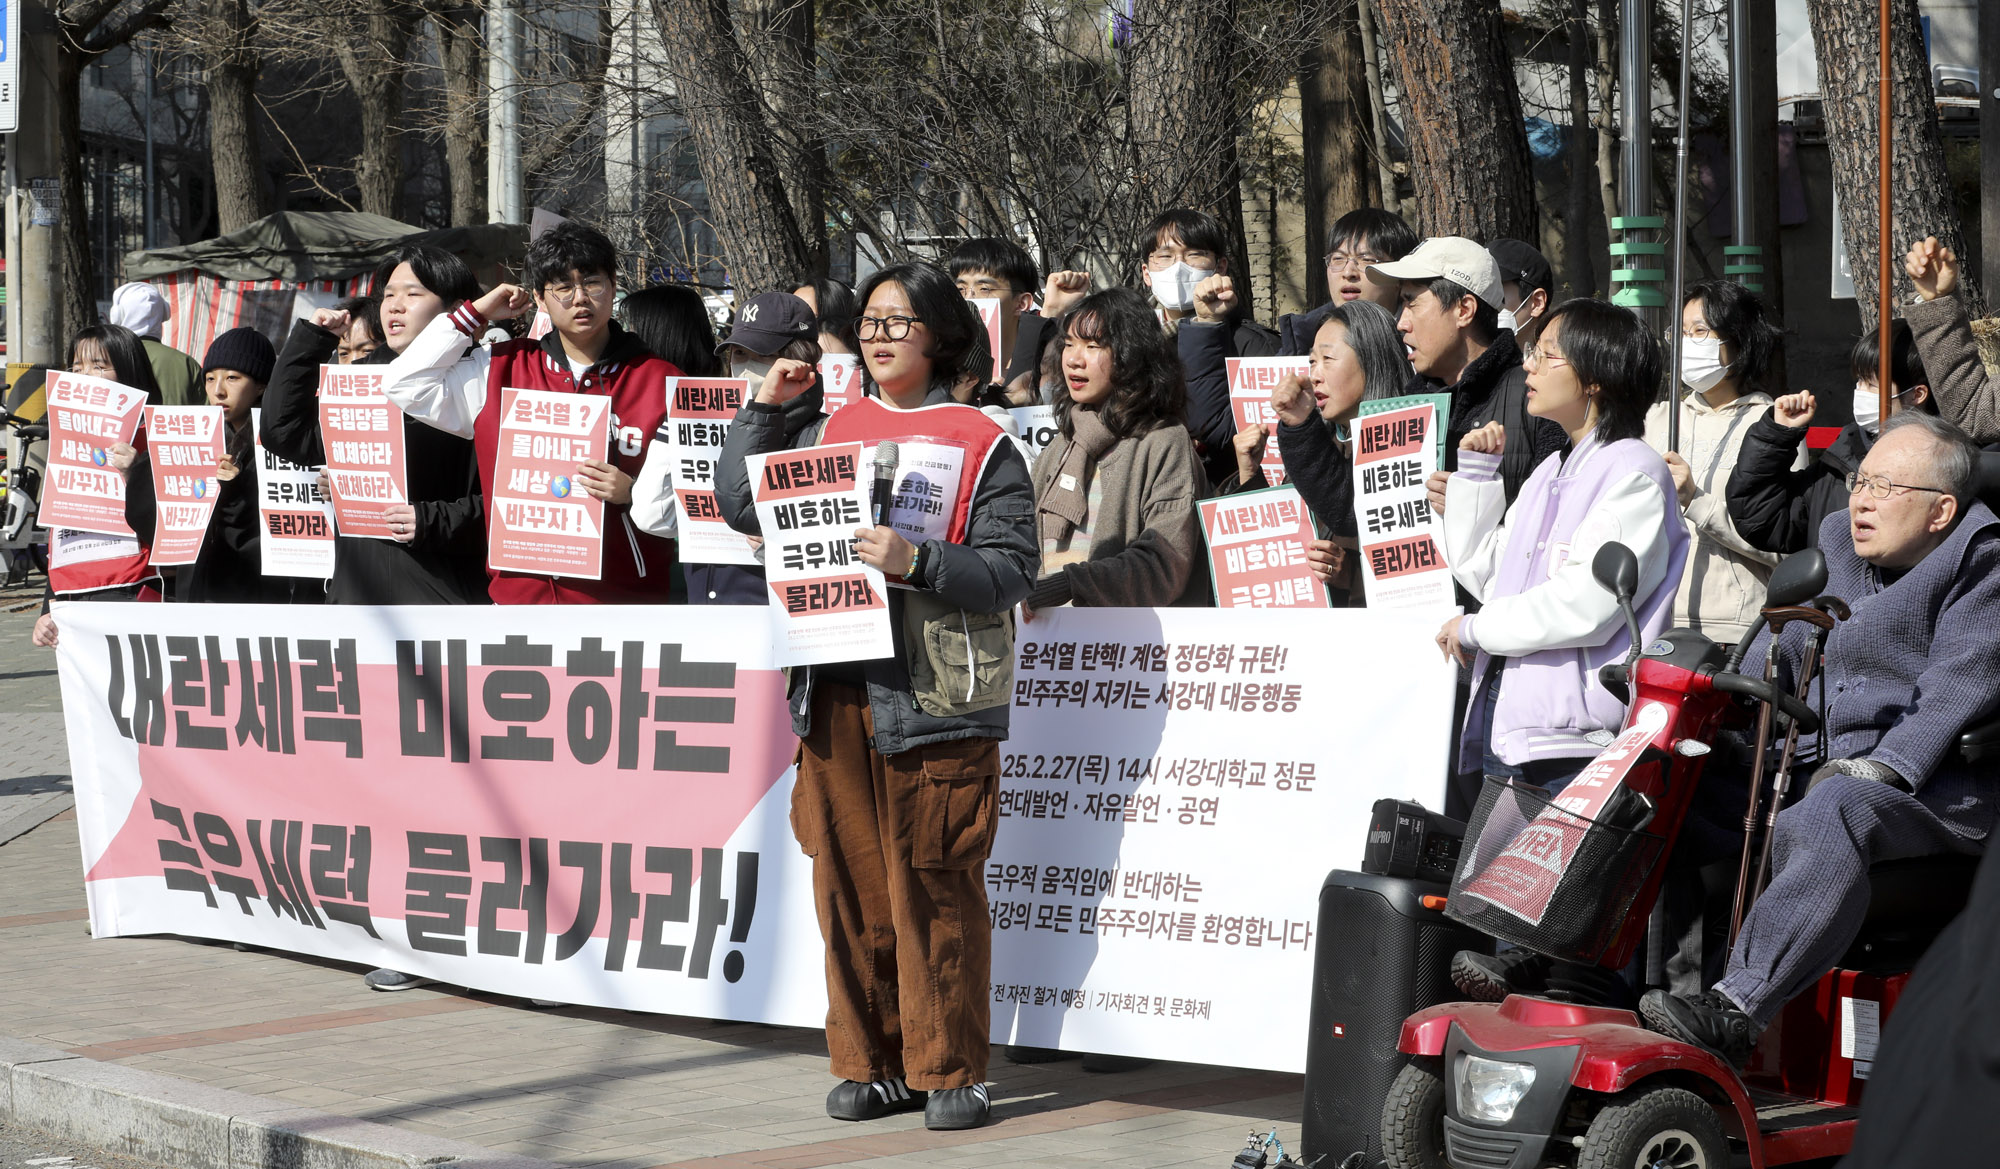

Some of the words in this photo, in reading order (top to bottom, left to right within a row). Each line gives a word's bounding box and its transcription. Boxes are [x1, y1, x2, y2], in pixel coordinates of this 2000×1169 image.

[1451, 269, 1471, 282] IZOD
[742, 303, 759, 322] NY
[326, 374, 384, 397] 내란동조
[832, 364, 844, 386] ?
[56, 380, 110, 406] 윤석열
[116, 393, 129, 411] ?
[676, 387, 741, 412] 내란세력
[57, 410, 122, 439] 몰아내고
[154, 414, 196, 435] 윤석열
[328, 407, 389, 432] 국힘당을
[515, 400, 570, 426] 윤석열
[580, 405, 591, 428] ?
[512, 434, 592, 463] 몰아내고
[678, 422, 731, 448] 비호하
[1360, 416, 1424, 456] 내란세력
[158, 445, 216, 466] 몰아내고
[332, 440, 392, 465] 해체하라
[58, 470, 108, 494] 바꾸자
[336, 473, 394, 499] 해체하라
[764, 455, 856, 490] 내란세력
[1362, 460, 1424, 494] 비호하는
[900, 479, 943, 498] 호하는
[165, 505, 200, 527] 바꾸자
[269, 514, 327, 536] 물러가라
[505, 502, 568, 530] 바꾸자
[774, 498, 860, 530] 비호하는
[1216, 499, 1300, 536] 내란세력
[1366, 499, 1432, 534] 극우세력
[1226, 540, 1306, 574] 비호하는
[1372, 538, 1437, 576] 물러가라
[786, 579, 872, 612] 물러가라
[1232, 576, 1314, 608] 극우세력
[1020, 642, 1076, 671] 윤석열
[1080, 642, 1126, 672] 탄핵!
[1130, 644, 1170, 672] 계엄
[1174, 644, 1234, 674] 정당화
[1238, 644, 1288, 674] 규탄!
[106, 634, 364, 759] 내란세력
[396, 635, 736, 773] 비호하는
[1014, 678, 1089, 708] 민주주의
[1092, 679, 1150, 710] 지키는
[1154, 680, 1216, 711] 서강대
[1220, 682, 1302, 712] 대응행동
[1002, 754, 1110, 785] 25.2.27(목)
[1117, 757, 1161, 785] 14시
[1164, 758, 1266, 788] 서강대학교
[1274, 761, 1316, 792] 정문
[999, 789, 1068, 819] 연대발언
[1084, 792, 1160, 823] 자유발언
[1178, 796, 1220, 826] 공연
[1370, 831, 1391, 844] MIPRO
[150, 798, 384, 940] 극우세력
[405, 830, 760, 984] 물러가라!
[986, 864, 1038, 894] 극우적
[1042, 865, 1118, 898] 움직임에
[1123, 870, 1202, 903] 반대하는
[1034, 904, 1072, 933] 모든
[1079, 906, 1196, 942] 민주주의자를
[1202, 914, 1312, 951] 환영합니다
[1007, 984, 1030, 1005] 자진
[1034, 986, 1058, 1007] 철거
[1060, 988, 1086, 1009] 예정
[1096, 991, 1149, 1014] 기자회견
[1154, 996, 1166, 1016] 및
[1170, 998, 1212, 1020] 문화제
